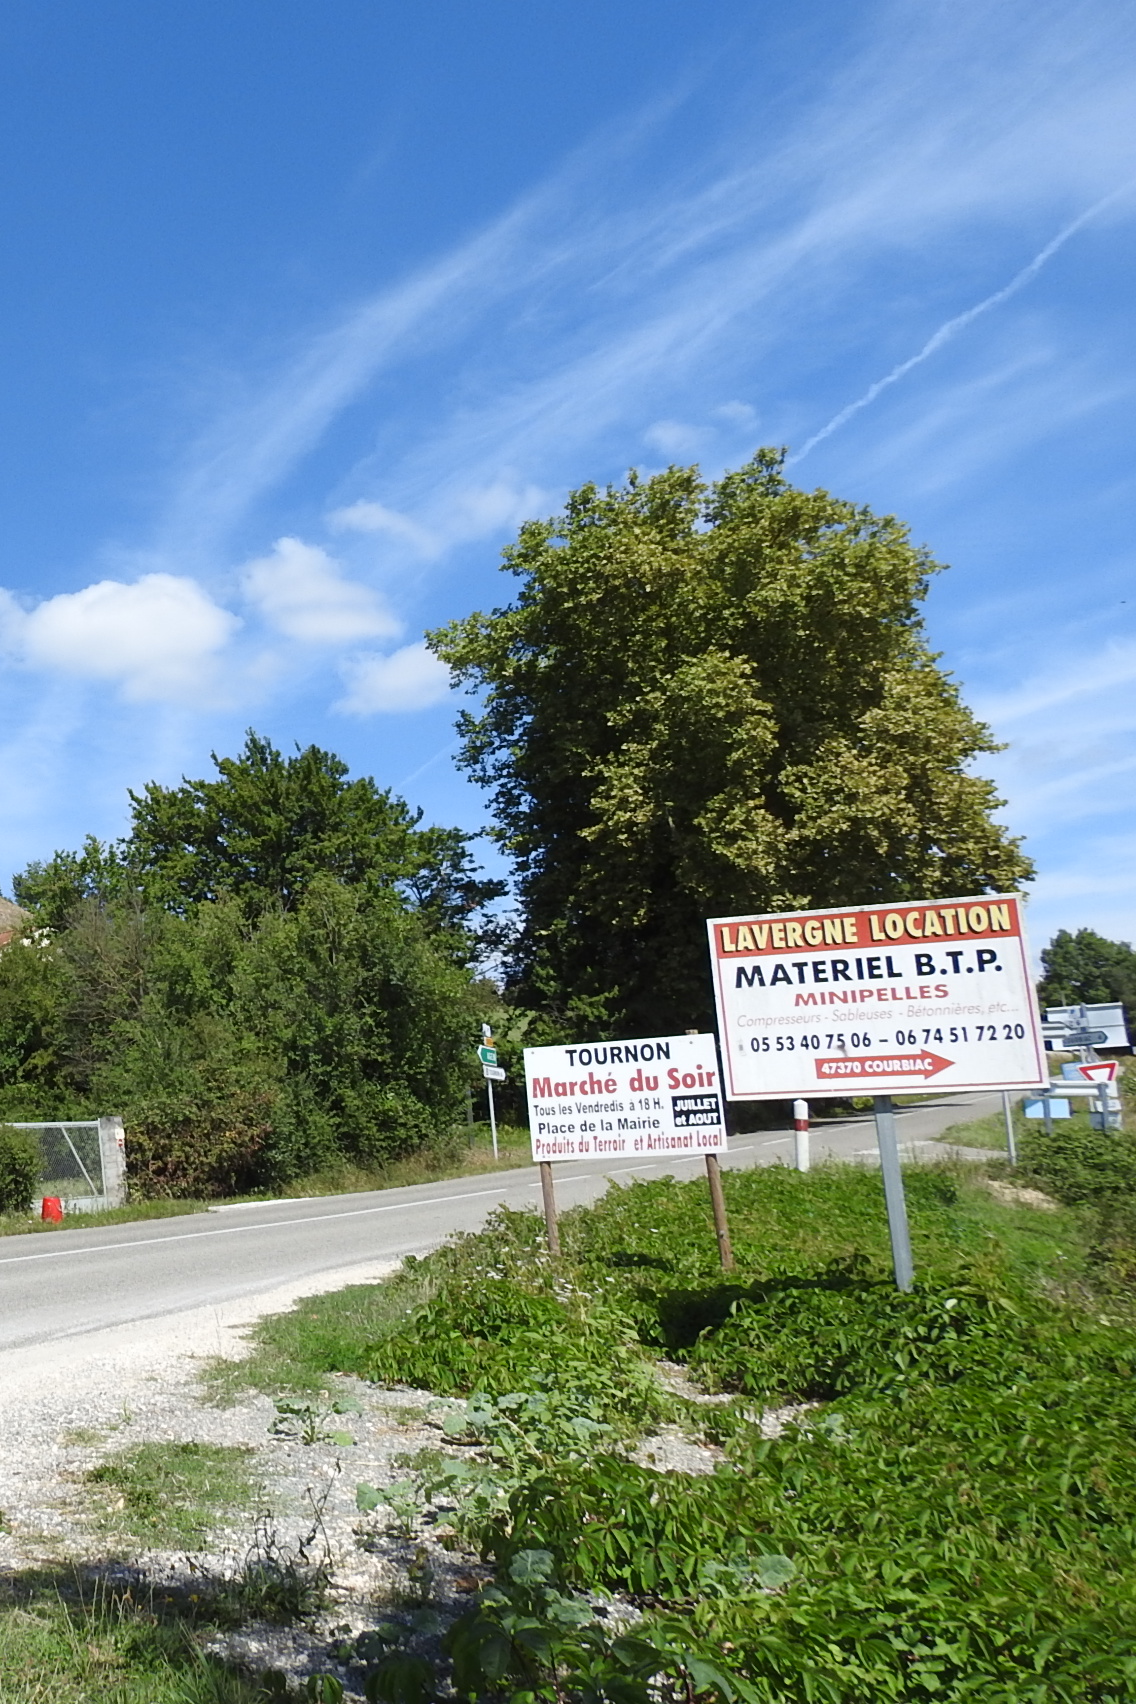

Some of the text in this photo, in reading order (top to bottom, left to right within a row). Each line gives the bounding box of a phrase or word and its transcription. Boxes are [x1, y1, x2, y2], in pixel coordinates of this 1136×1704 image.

[721, 903, 1011, 952] LAVERGNE LOCATION
[735, 949, 1002, 988] MATERIEL B.T.P.
[795, 984, 949, 1006] MINIPELLES
[737, 1013, 821, 1028] Compresseurs
[832, 1008, 892, 1022] Sableuses
[751, 1037, 770, 1052] 05
[776, 1036, 795, 1051] 53
[800, 1034, 820, 1050] 40
[825, 1033, 846, 1049] 75
[851, 1032, 871, 1048] 06
[895, 1030, 917, 1046] 06
[922, 1028, 943, 1044] 74
[949, 1027, 968, 1042] 51
[975, 1025, 997, 1041] 72
[1003, 1023, 1025, 1040] 20
[565, 1042, 670, 1066] TOURNON
[821, 1058, 933, 1074] 47370 COURBIAC
[532, 1071, 617, 1098] Marché
[629, 1069, 659, 1092] du
[667, 1064, 715, 1090] Soir
[534, 1097, 664, 1117] Tous les Vendredis à 18 H.
[674, 1097, 716, 1111] JUILLET
[539, 1117, 660, 1135] Place de la Mairie
[675, 1113, 718, 1126] et AOUT
[535, 1128, 722, 1155] Produits du Terroir et Artisanat Local
